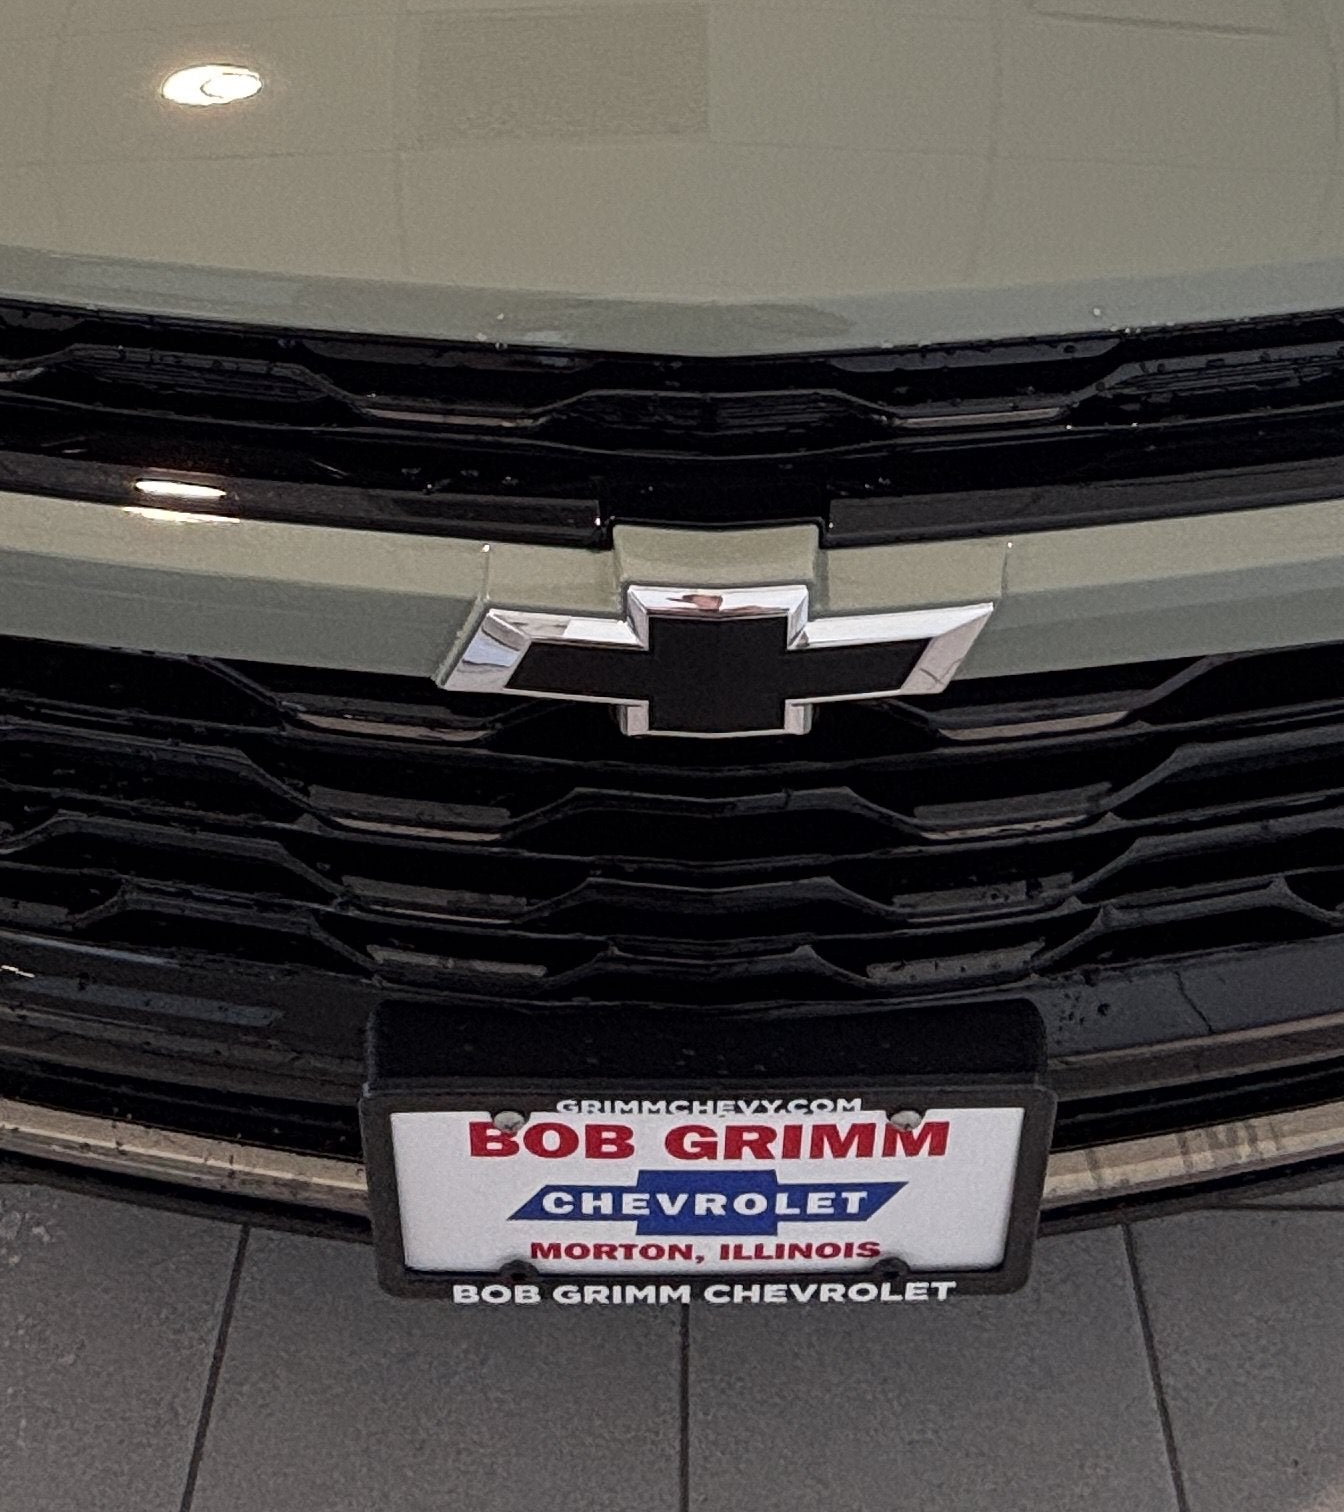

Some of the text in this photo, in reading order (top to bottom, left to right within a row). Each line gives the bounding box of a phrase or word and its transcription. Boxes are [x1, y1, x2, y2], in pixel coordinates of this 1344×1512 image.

[556, 1098, 863, 1116] GRIMMCHEVY.COM
[468, 1120, 950, 1161] BOB GRIMM
[542, 1190, 868, 1216] CHEVROLET
[530, 1241, 881, 1264] MORTON, ILLINOIS
[452, 1281, 957, 1305] BOB GRIMM CHEVROLET
